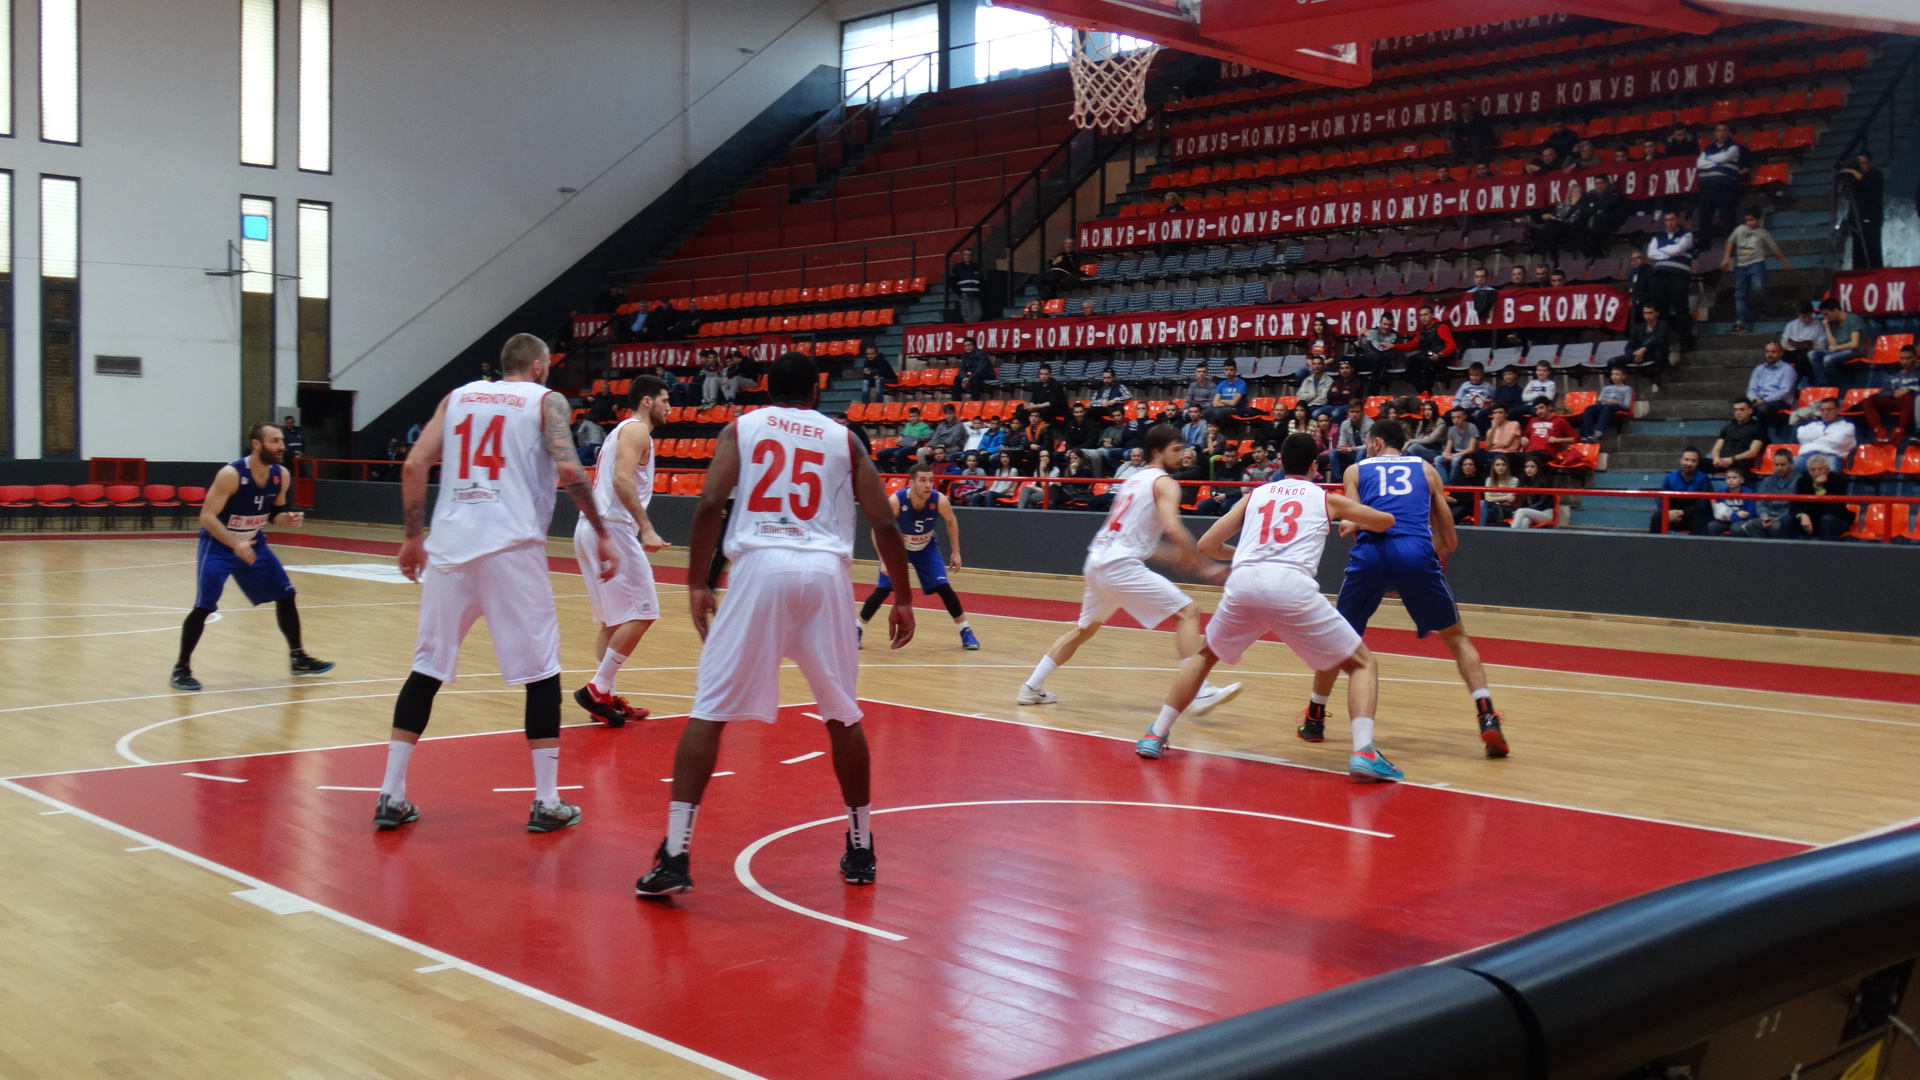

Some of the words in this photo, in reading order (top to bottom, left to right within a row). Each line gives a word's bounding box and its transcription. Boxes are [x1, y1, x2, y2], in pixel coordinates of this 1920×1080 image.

[1470, 91, 1540, 116] ОЖУВ
[1839, 281, 1920, 312] КОЖ
[767, 415, 826, 441] SNAER
[454, 413, 507, 481] 14
[747, 438, 826, 521] 25
[1375, 465, 1413, 497] 13
[253, 495, 264, 511] 4
[914, 520, 925, 533] 5
[1257, 499, 1304, 545] 13
